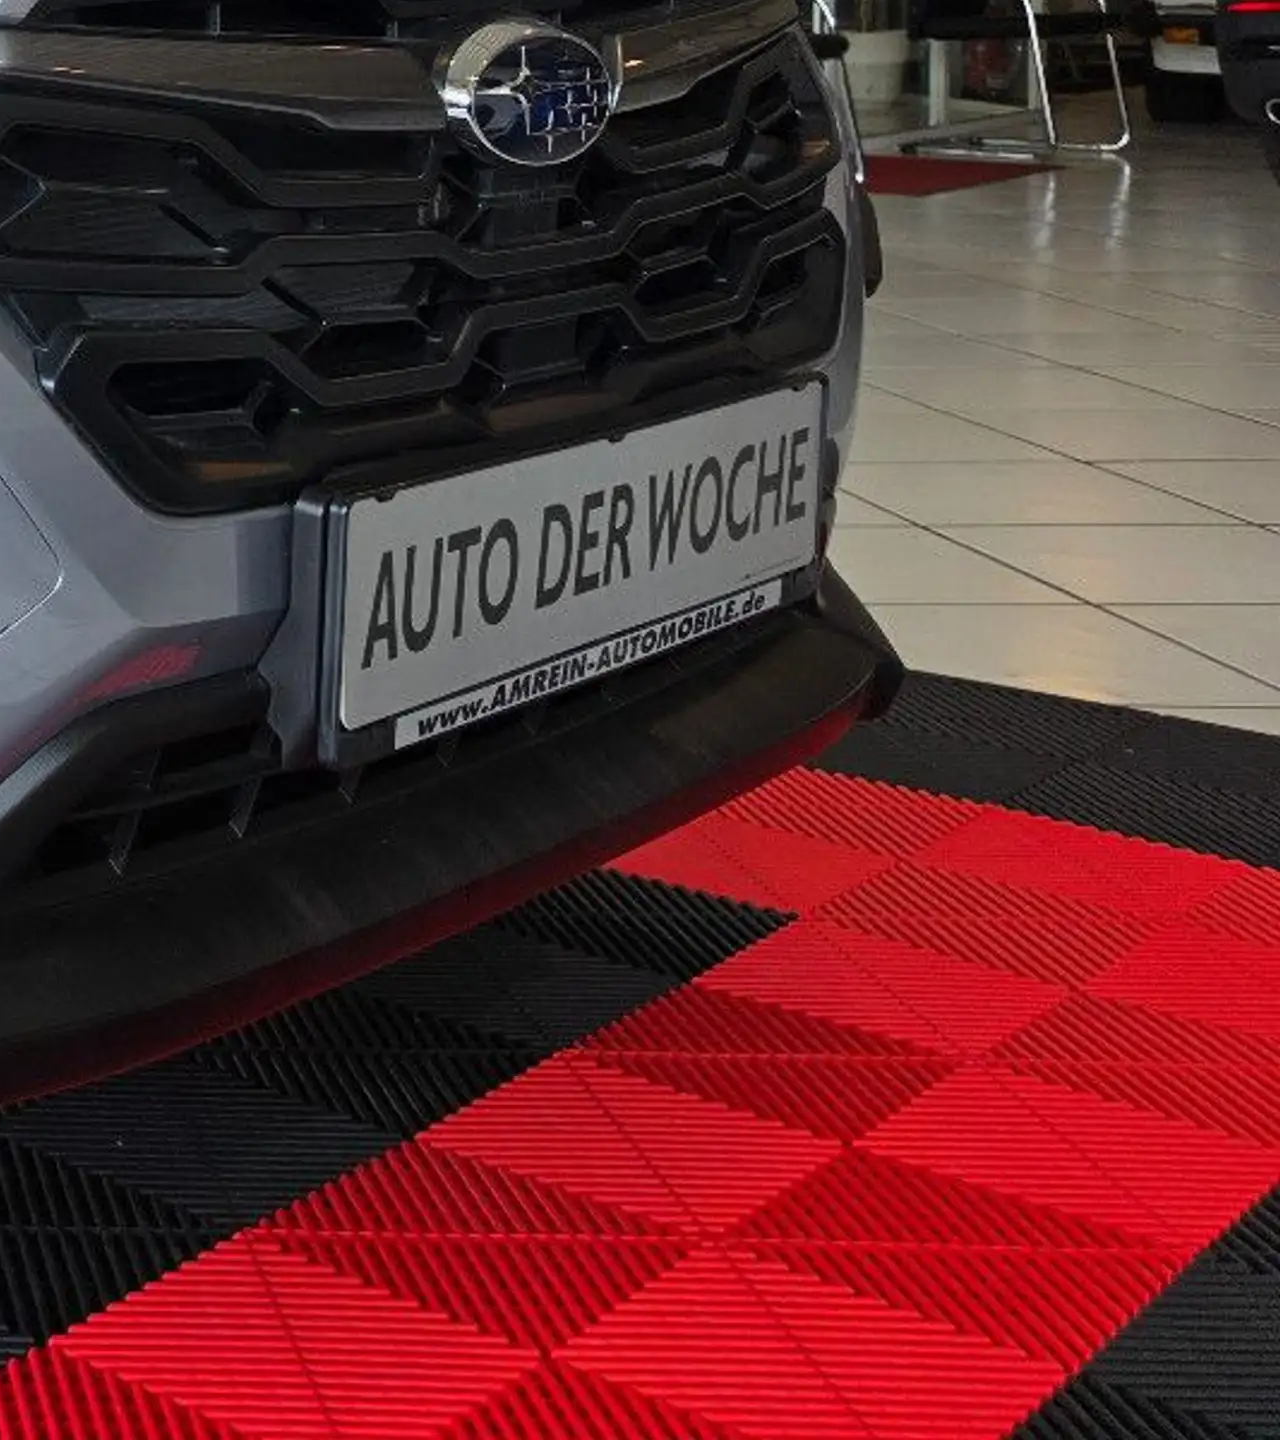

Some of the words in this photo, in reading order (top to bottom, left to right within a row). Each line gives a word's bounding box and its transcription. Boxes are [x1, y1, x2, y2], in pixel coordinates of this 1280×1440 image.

[361, 518, 519, 669] AUTO
[534, 482, 636, 610] DER
[648, 426, 810, 571] WOCHE
[417, 590, 766, 737] www.AMREIN-AUTOMOBILE.de
